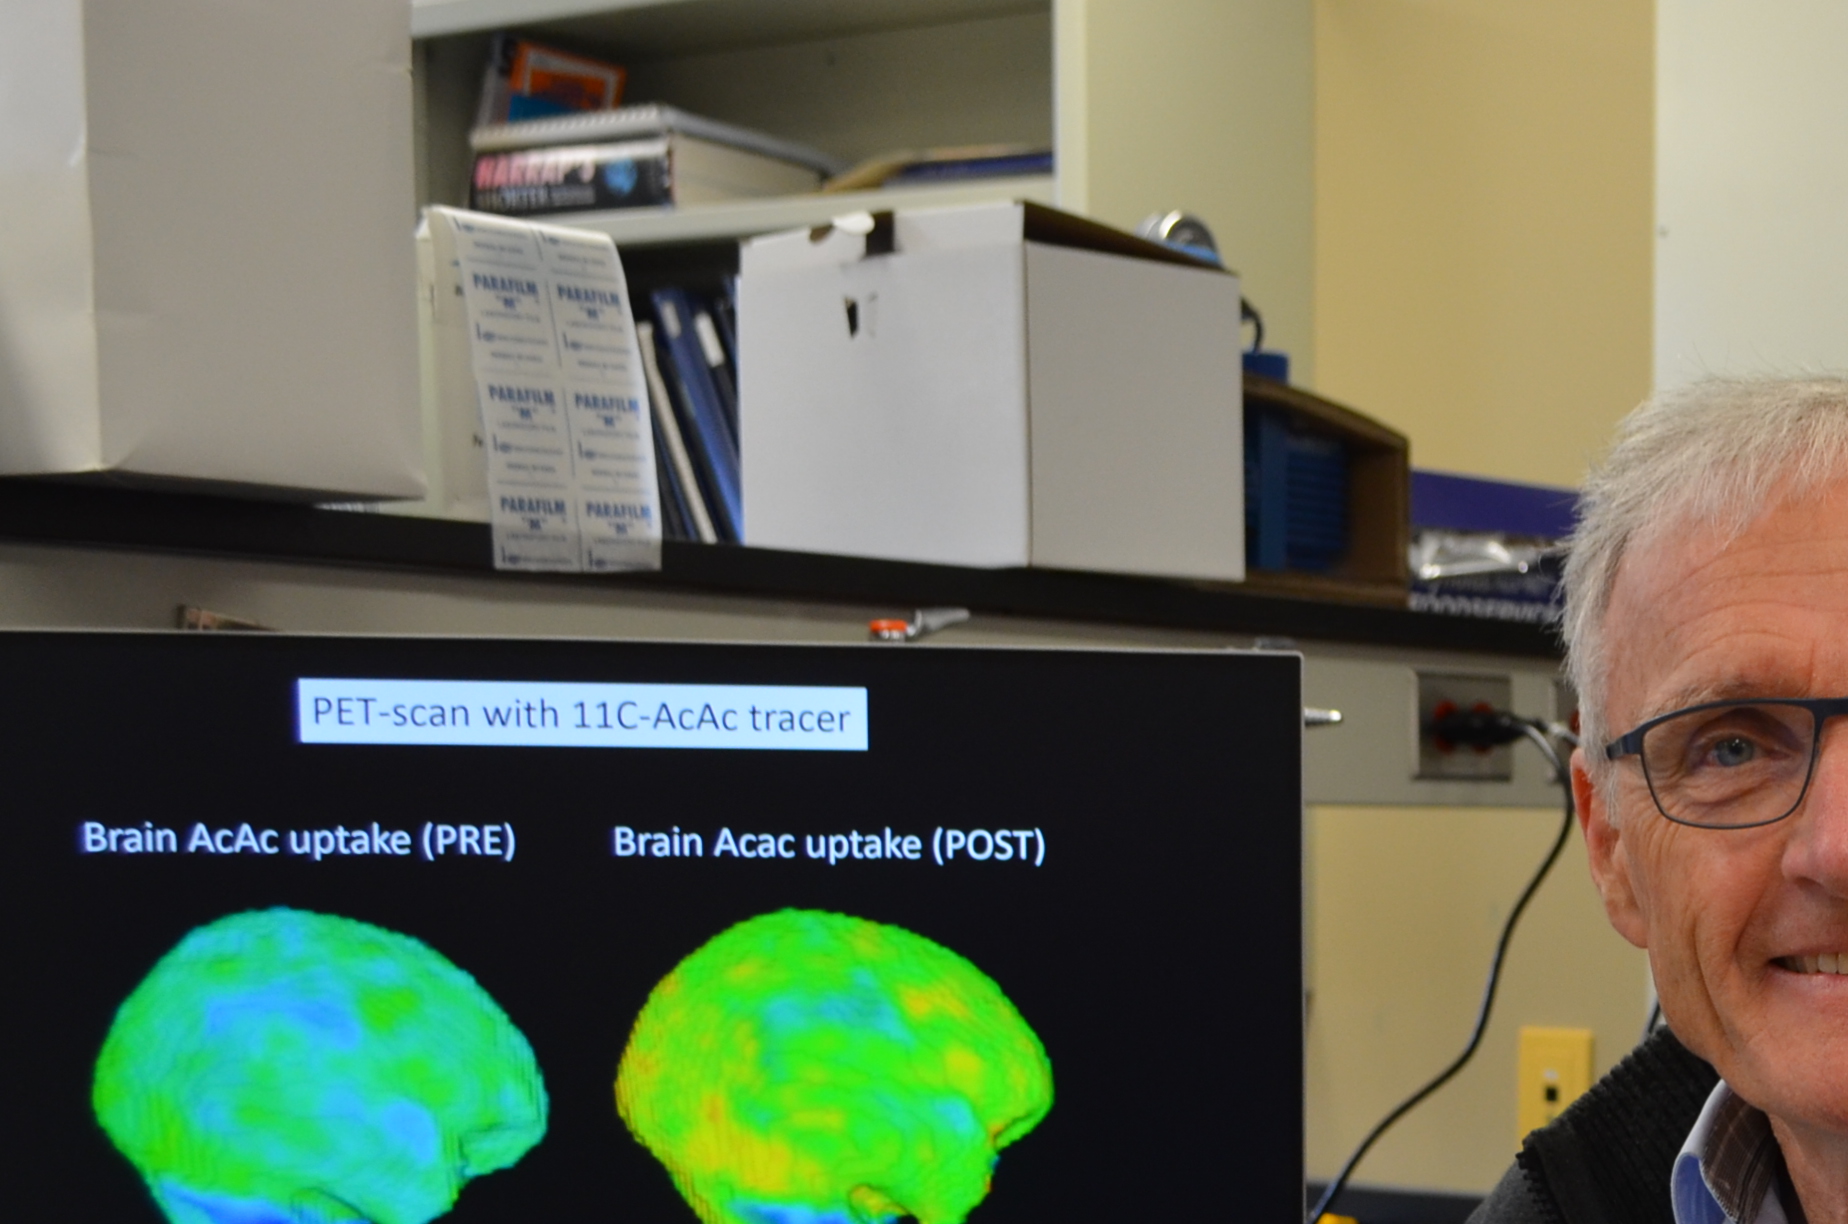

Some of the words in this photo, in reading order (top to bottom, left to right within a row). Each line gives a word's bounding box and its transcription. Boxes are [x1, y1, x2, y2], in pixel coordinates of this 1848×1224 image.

[473, 273, 539, 296] PARAFILM
[557, 284, 621, 306] PARAFILM
[488, 385, 555, 407] PARAFILM
[575, 393, 640, 413] PARAFILM
[501, 496, 566, 516] PARAFILM
[587, 502, 652, 519] PARAFILM
[313, 697, 470, 726] PET-scan
[482, 698, 559, 728] with
[573, 700, 738, 731] 11C-AcAc
[749, 705, 851, 732] tracer
[83, 821, 178, 853] Brain
[187, 822, 279, 854] AcAc
[289, 822, 412, 861] uptake
[422, 821, 516, 861] (PRE)
[613, 826, 703, 857] Brain
[713, 827, 796, 858] Acac
[805, 827, 922, 866] uptake
[932, 827, 1046, 867] (POST)
